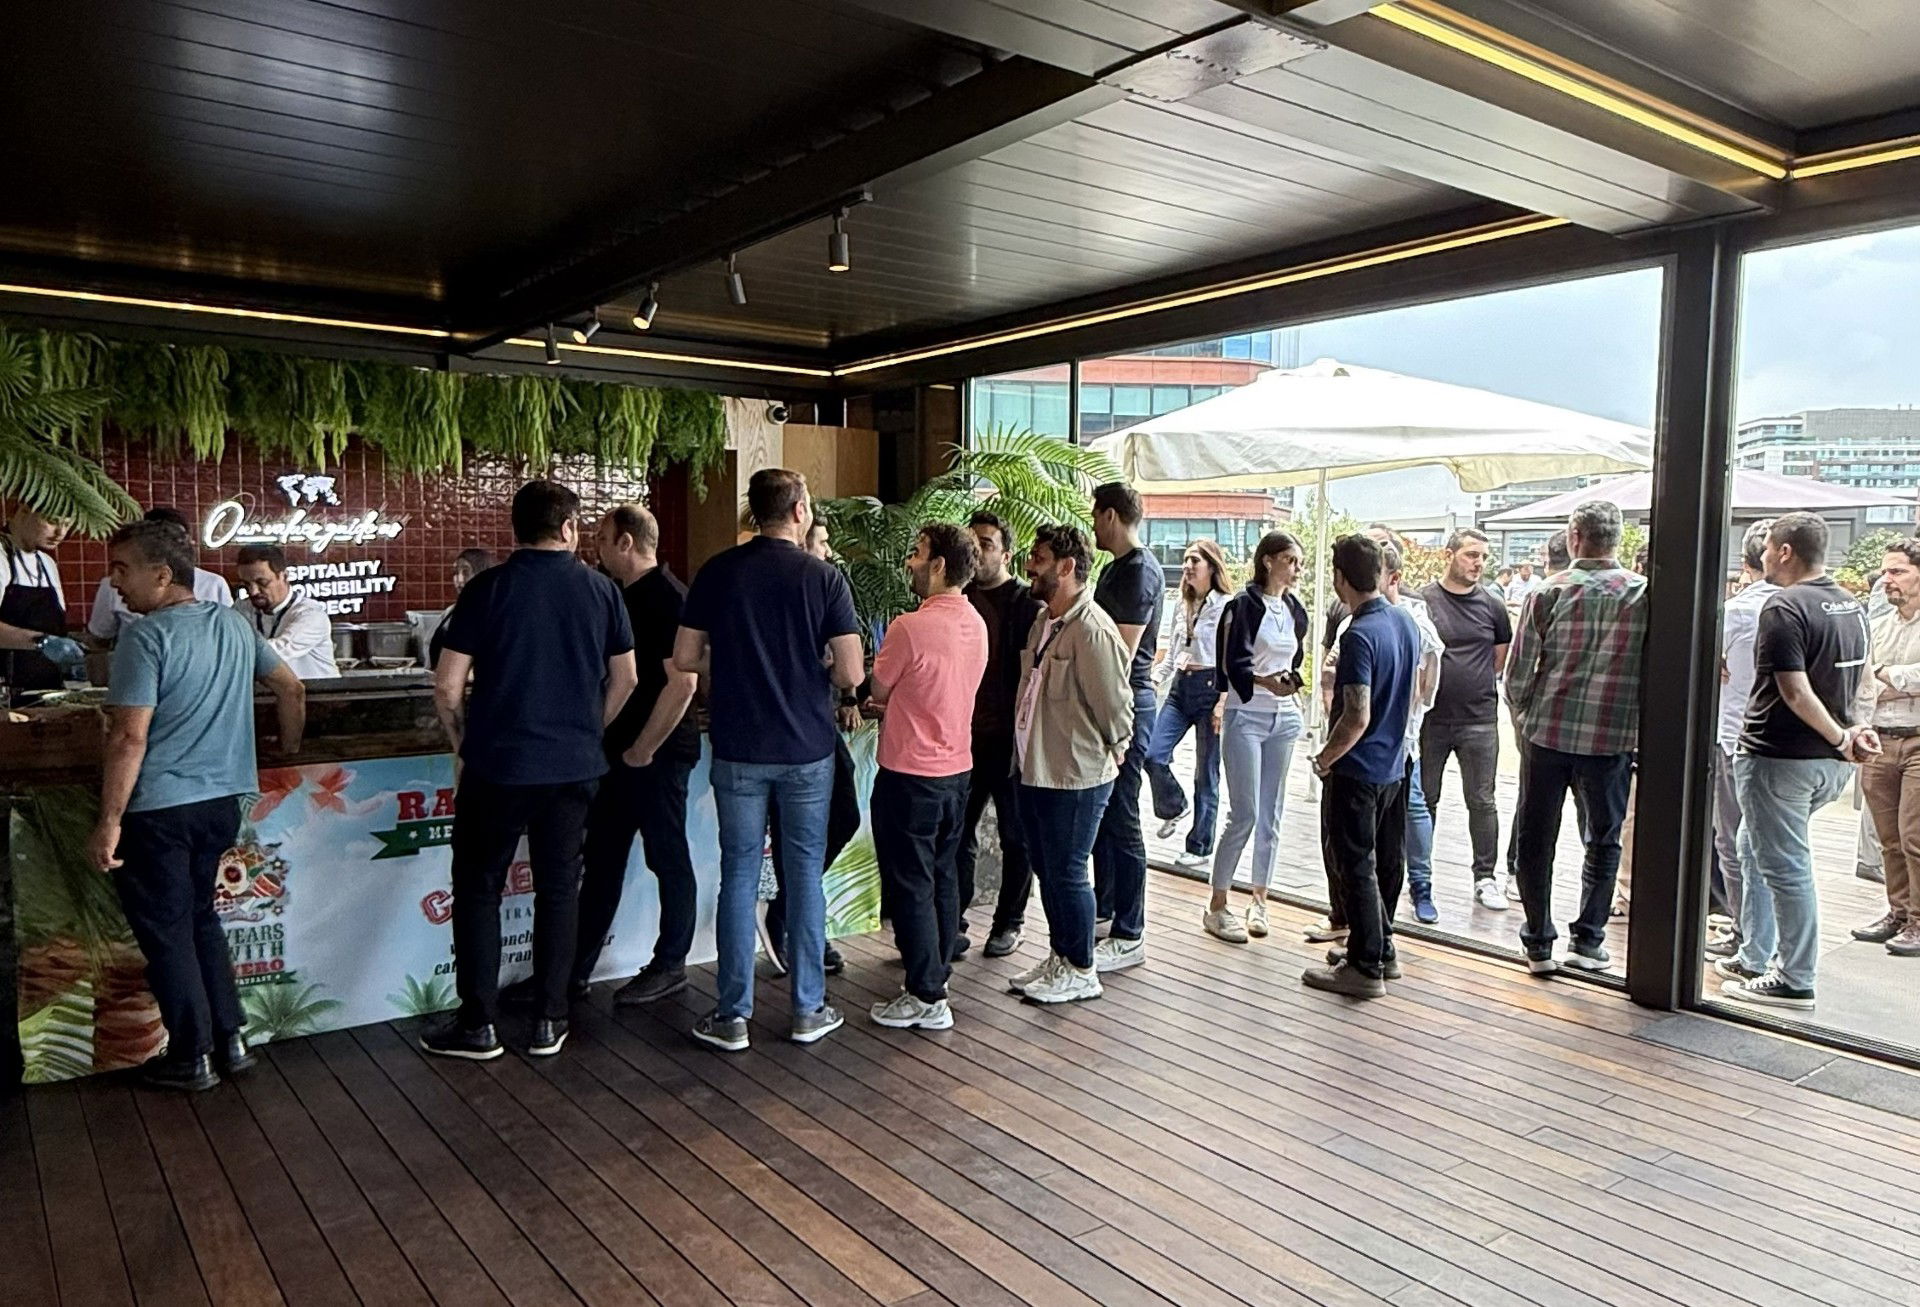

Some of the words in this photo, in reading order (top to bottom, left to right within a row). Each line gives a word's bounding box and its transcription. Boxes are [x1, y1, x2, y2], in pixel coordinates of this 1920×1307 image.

[286, 560, 381, 581] SPITALITY
[292, 577, 397, 598] ONSIBILITY
[397, 788, 455, 821] RA
[429, 825, 453, 840] ME
